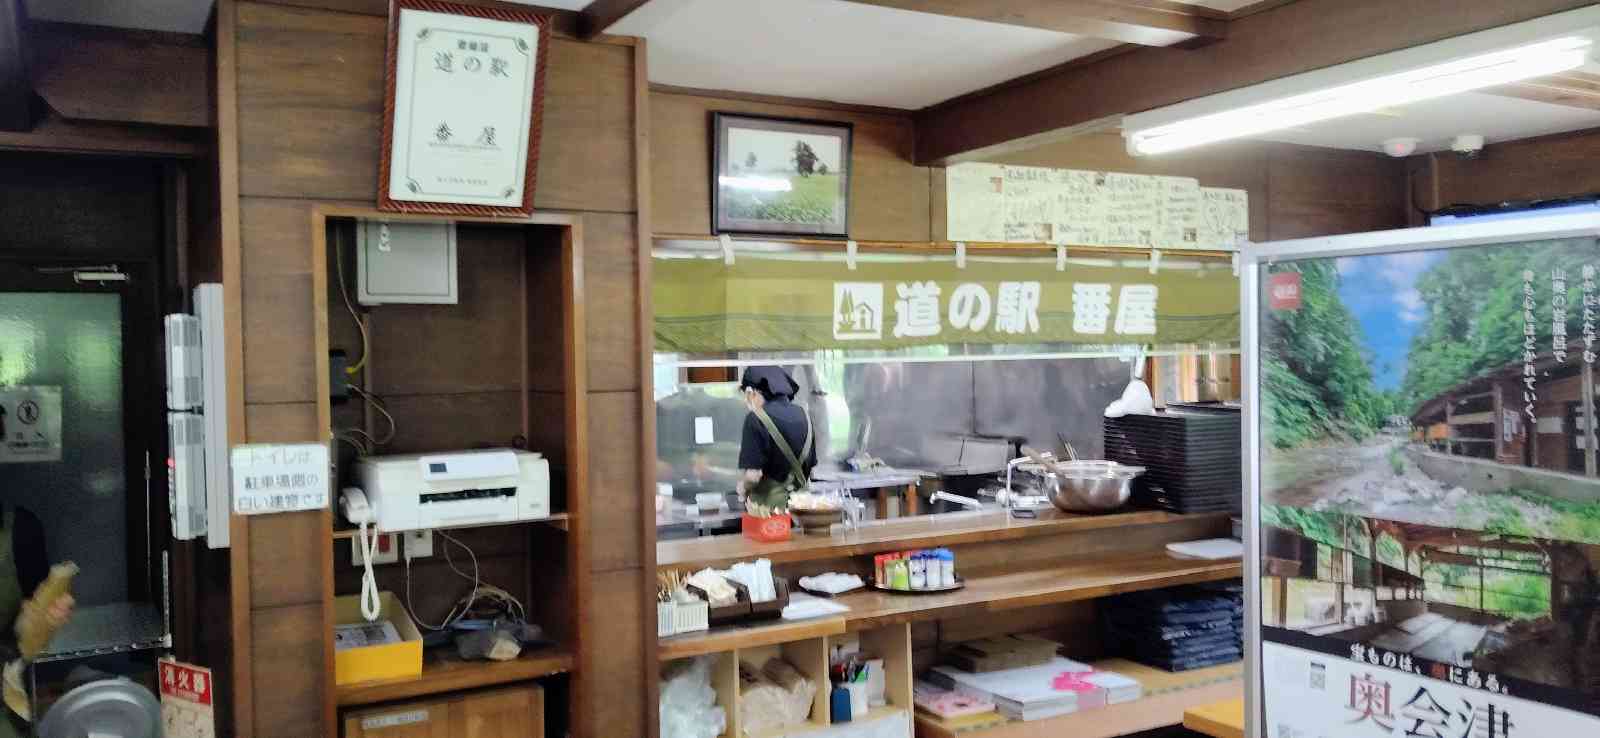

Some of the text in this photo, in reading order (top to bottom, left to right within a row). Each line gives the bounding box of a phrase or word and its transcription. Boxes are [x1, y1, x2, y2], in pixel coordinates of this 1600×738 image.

[433, 50, 509, 78] 道の駅
[893, 280, 1158, 337] 道の駅 番屋
[251, 448, 312, 466] トイレは
[238, 494, 323, 511] 白い建物です
[164, 664, 205, 694] 消火器
[1345, 673, 1515, 738] 奥会津
